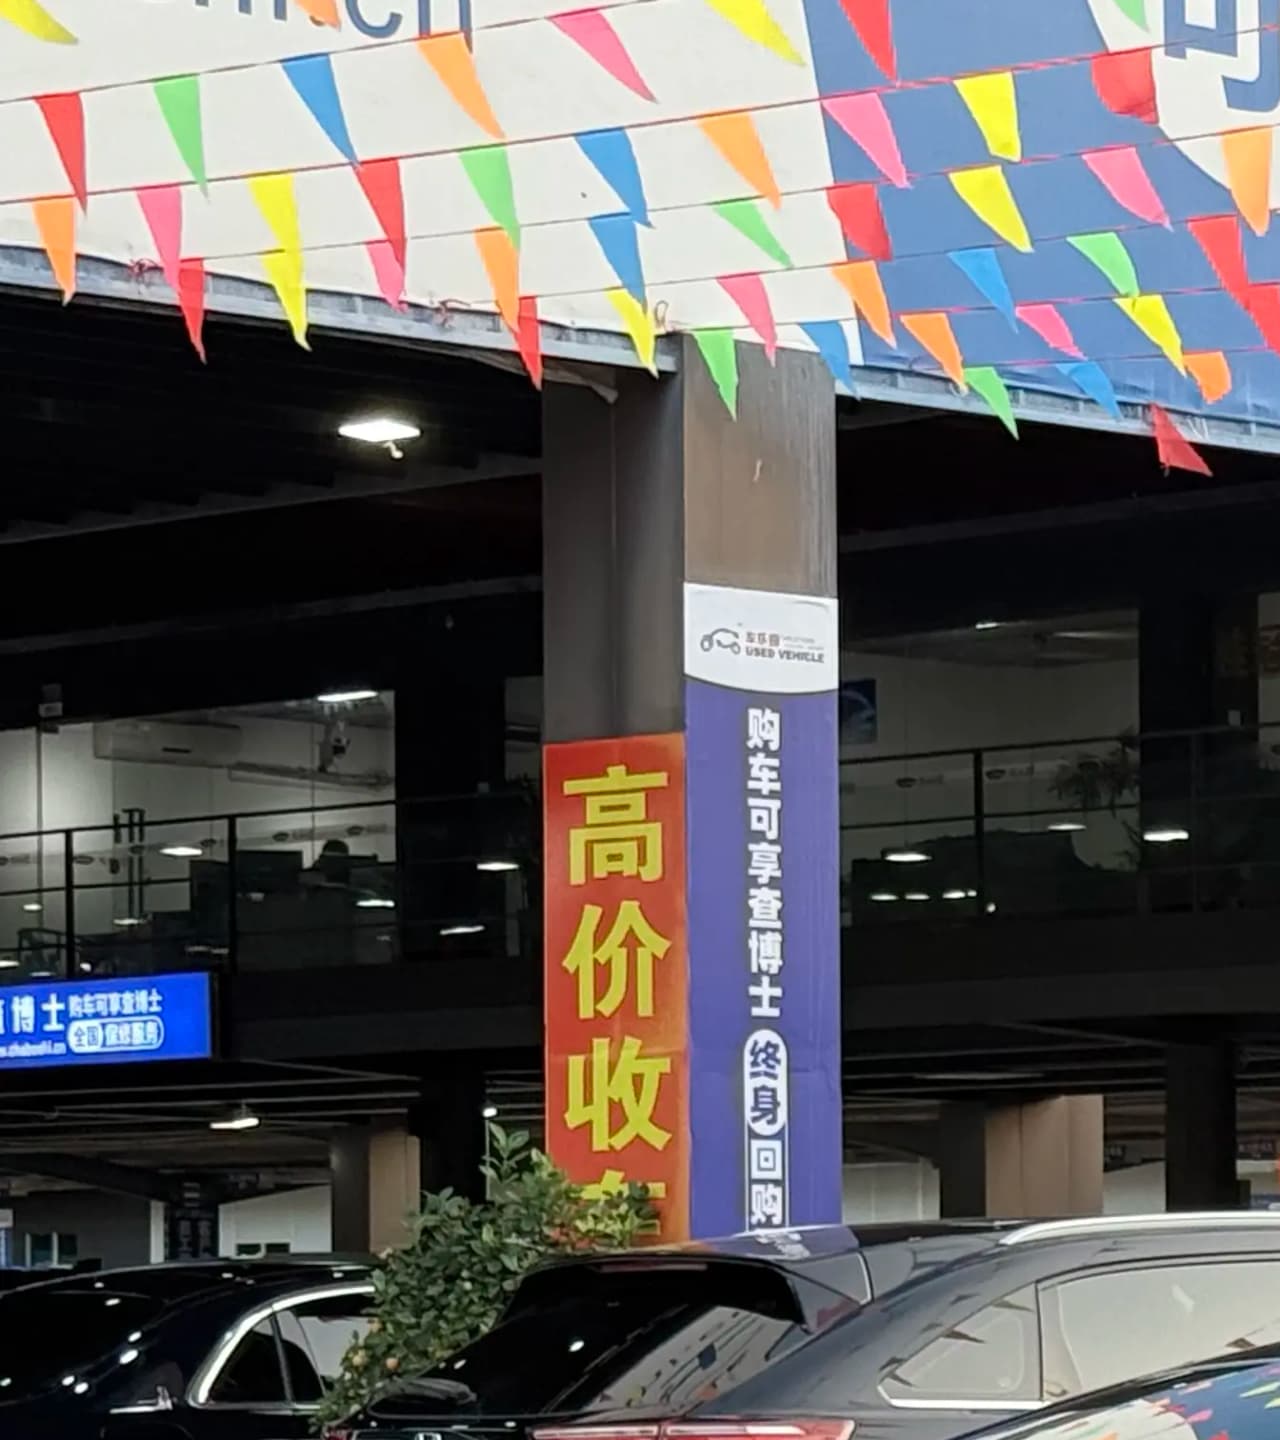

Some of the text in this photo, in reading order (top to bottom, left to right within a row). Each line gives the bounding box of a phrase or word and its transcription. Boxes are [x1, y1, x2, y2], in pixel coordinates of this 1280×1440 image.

[745, 647, 825, 664] USED VEHICLE
[746, 707, 784, 1018] 购车可享查博士
[0, 993, 66, 1034] 博士
